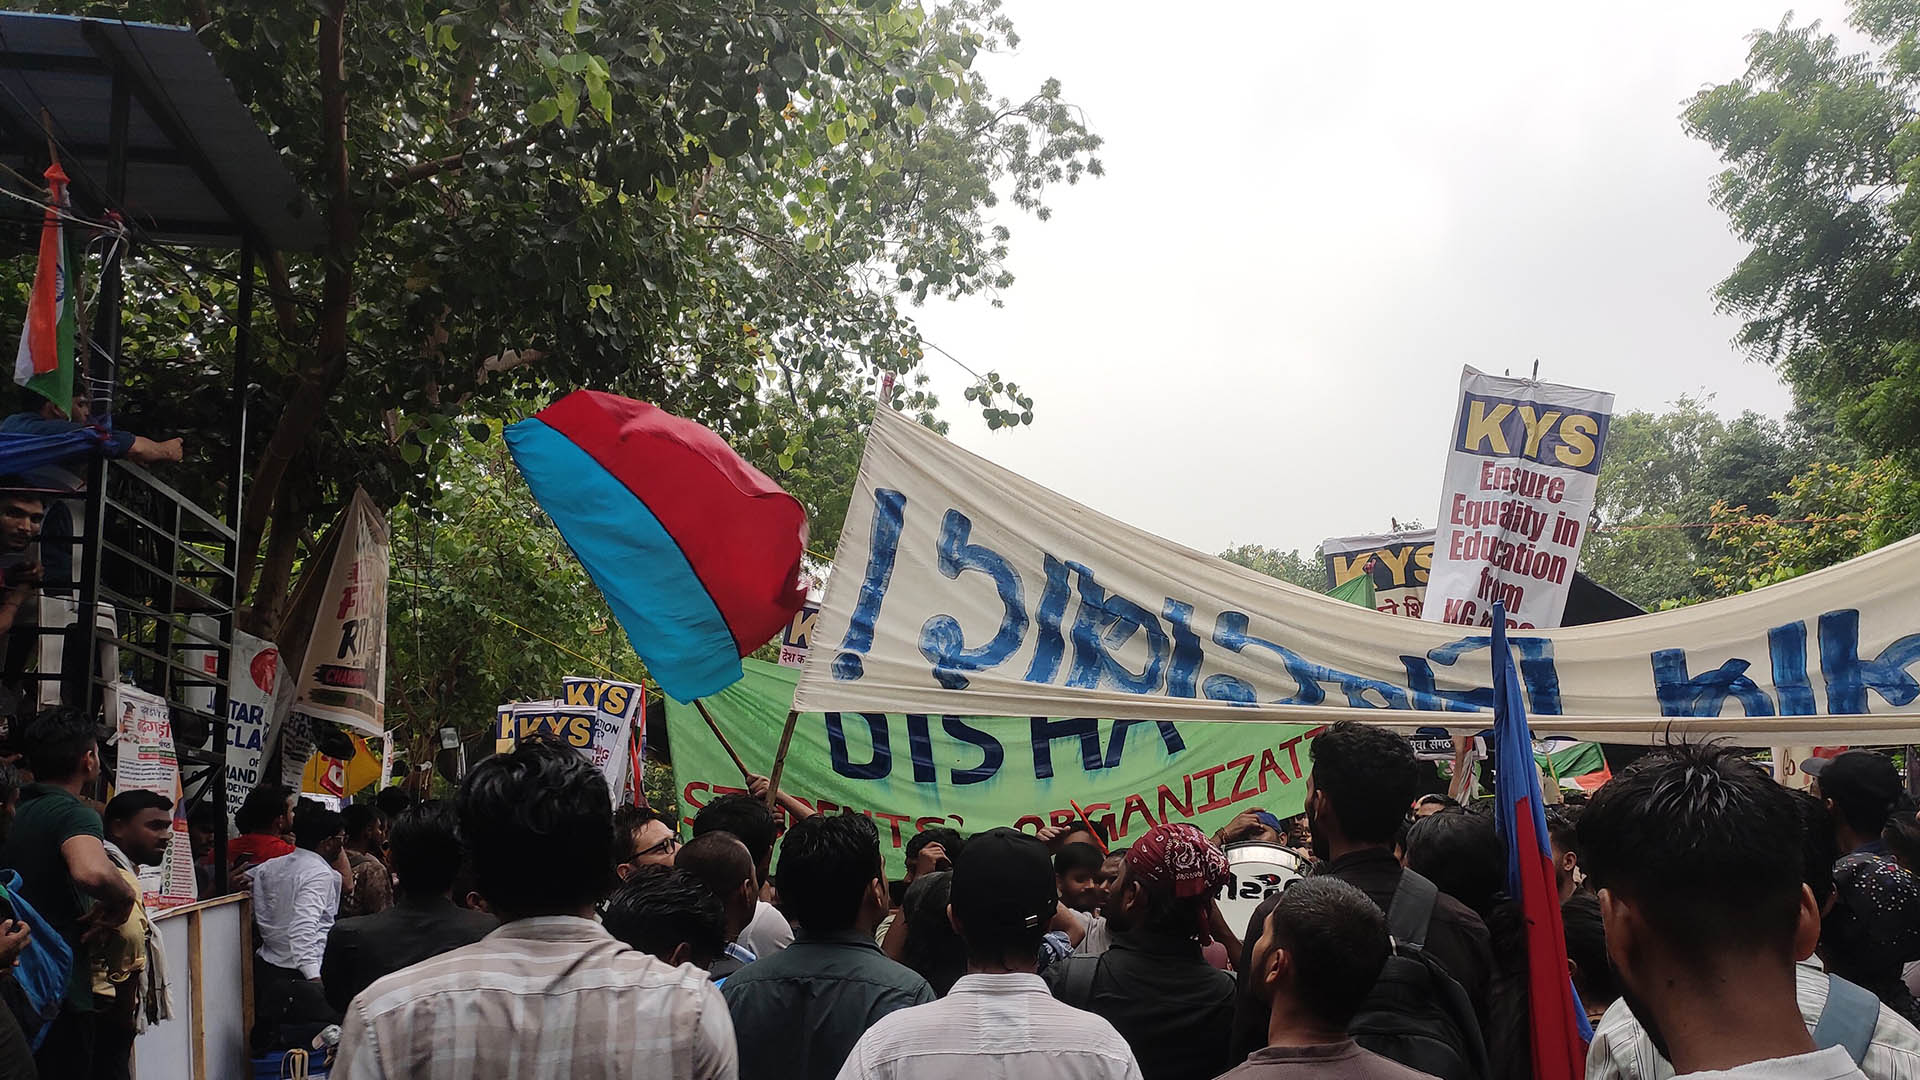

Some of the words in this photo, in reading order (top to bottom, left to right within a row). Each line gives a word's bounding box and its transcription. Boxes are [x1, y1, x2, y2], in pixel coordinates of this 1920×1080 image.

[1465, 400, 1599, 468] KYS
[1479, 460, 1566, 504] Ensure
[1450, 493, 1548, 543] Equality
[1552, 511, 1580, 548] in
[1449, 529, 1568, 585] Education
[1477, 567, 1524, 616] from
[567, 683, 628, 715] KYS
[520, 715, 591, 747] KYS
[825, 710, 1186, 781] DISHA
